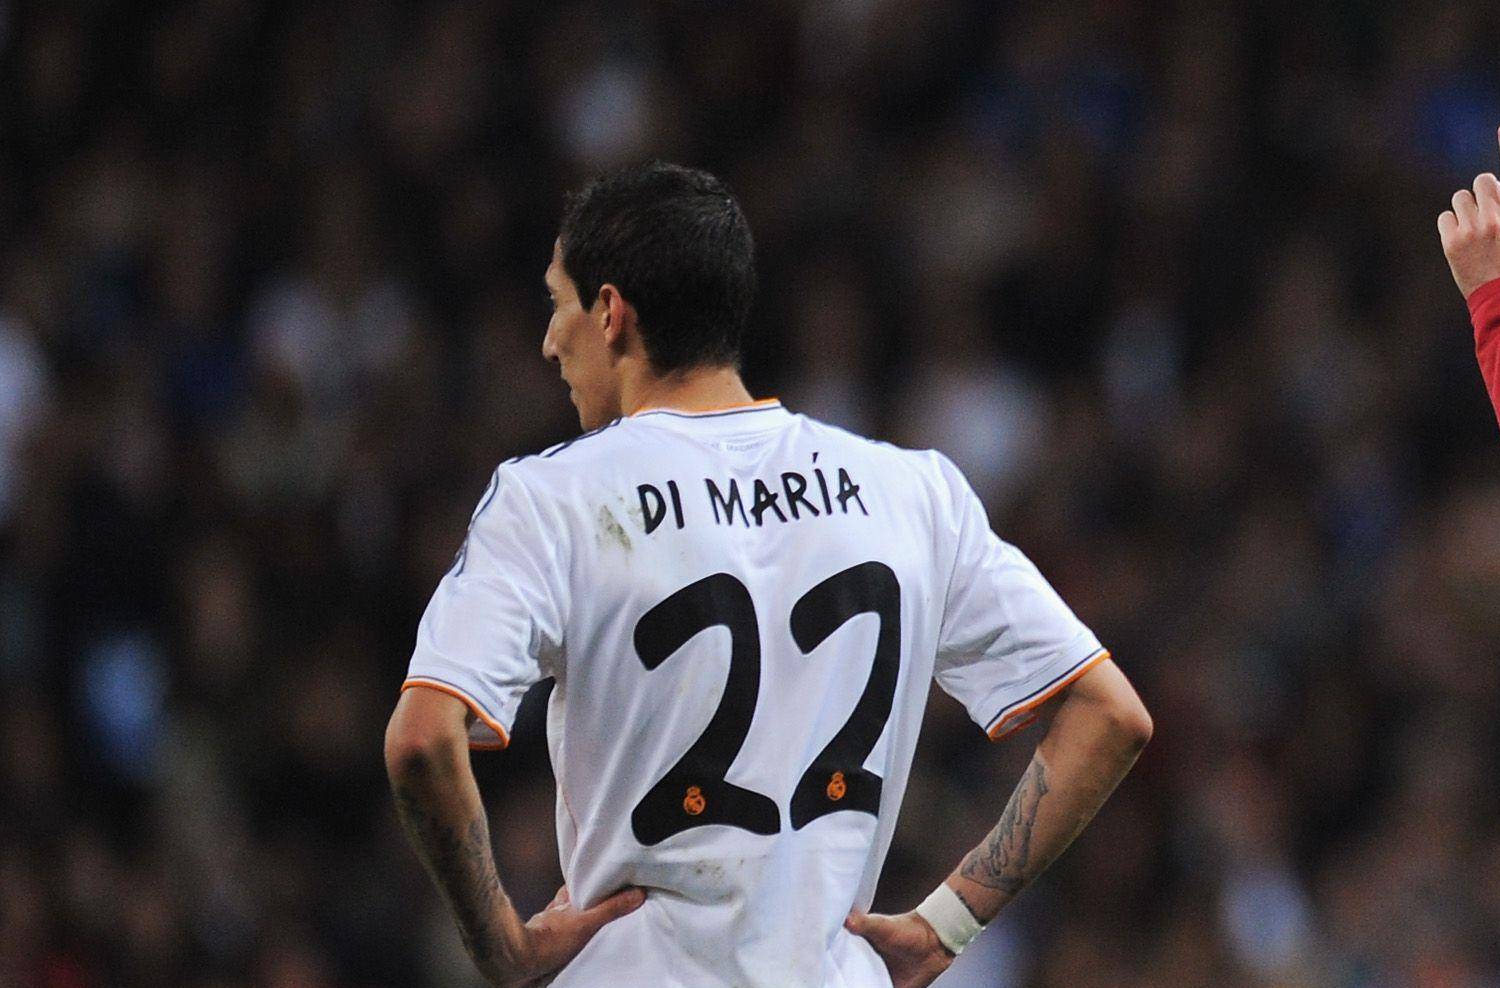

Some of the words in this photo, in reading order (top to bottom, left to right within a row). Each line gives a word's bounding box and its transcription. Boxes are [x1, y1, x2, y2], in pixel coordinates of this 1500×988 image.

[637, 480, 685, 535] DI
[705, 452, 869, 528] MARÍA
[632, 561, 901, 846] 22
